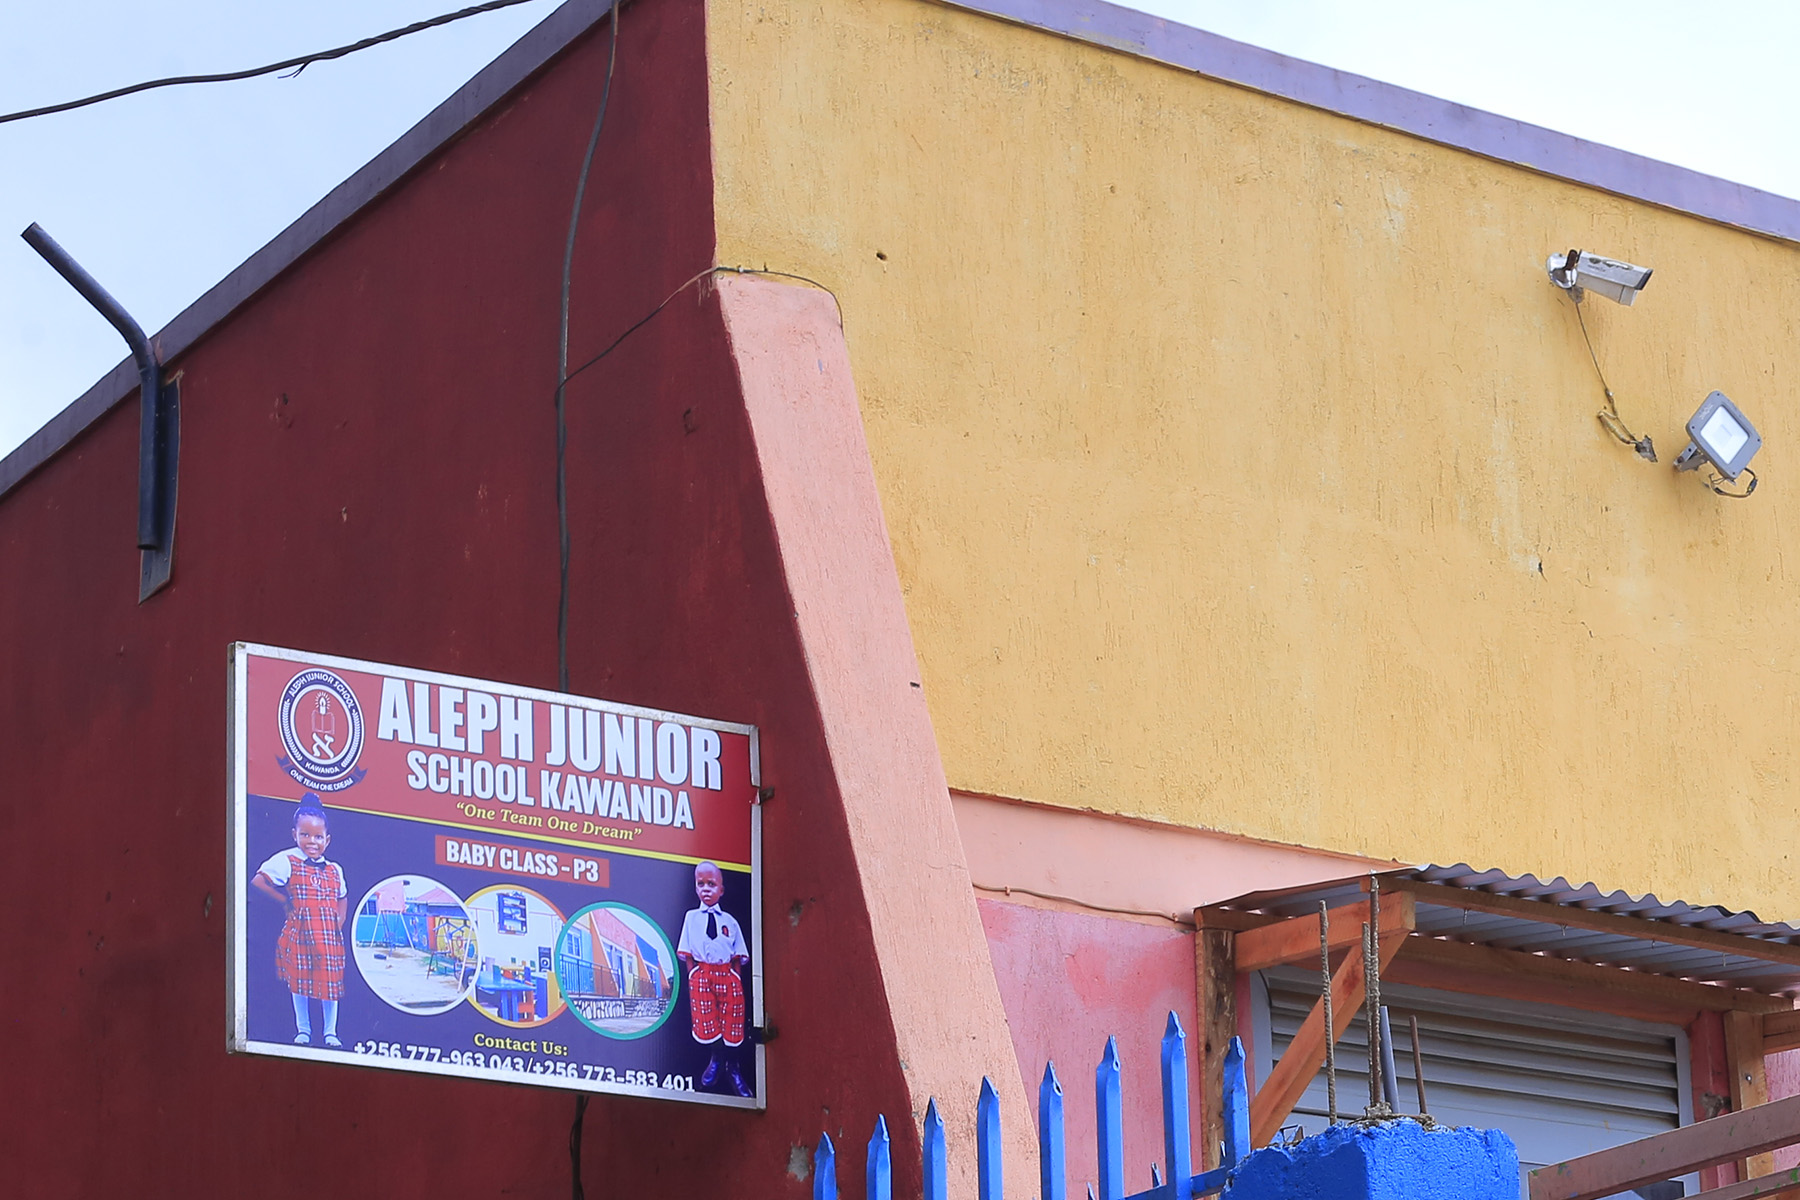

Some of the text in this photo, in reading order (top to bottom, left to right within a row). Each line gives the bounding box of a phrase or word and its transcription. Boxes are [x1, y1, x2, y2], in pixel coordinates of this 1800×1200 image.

[288, 675, 308, 697] ALEPH
[334, 680, 355, 709] SCHOOL
[377, 677, 723, 791] ALEPH JUNIOR
[305, 761, 340, 774] KAWANDA
[406, 750, 695, 830] SCHOOL KAWANDA
[501, 809, 543, 828] Team
[547, 815, 578, 833] One
[446, 839, 497, 868] BABY
[499, 848, 558, 877] CLASS
[573, 859, 599, 883] P3
[474, 1033, 568, 1056] Contact Us:
[662, 1074, 695, 1092] 401
